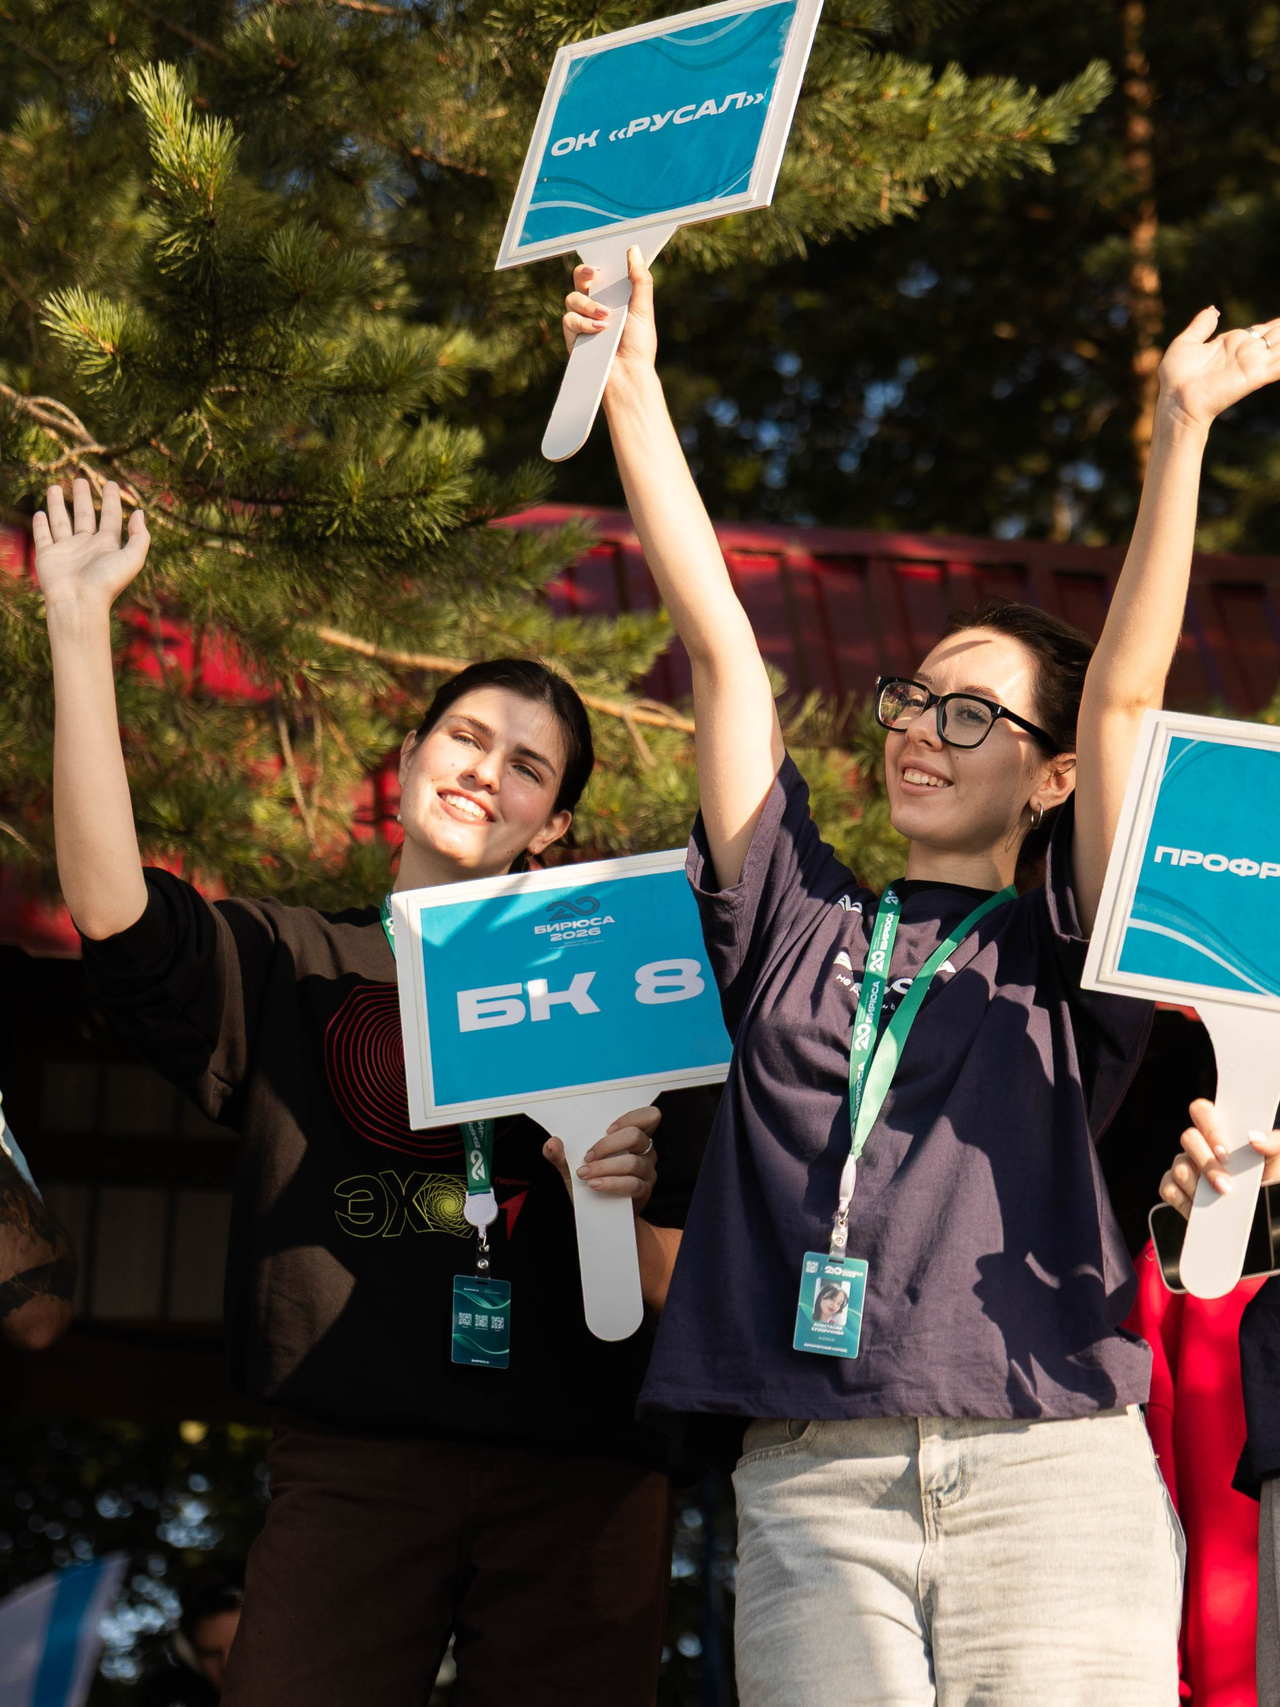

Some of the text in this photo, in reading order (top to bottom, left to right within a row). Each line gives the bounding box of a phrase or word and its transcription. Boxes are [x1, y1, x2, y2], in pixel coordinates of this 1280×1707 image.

[551, 91, 765, 157] ОК «РУСАЛ»
[534, 915, 616, 934] БИРЮСА
[550, 927, 601, 942] 2026
[880, 911, 896, 951] БИРЮСА
[456, 958, 705, 1033] БК 8
[865, 980, 881, 1024] БИРЮСА
